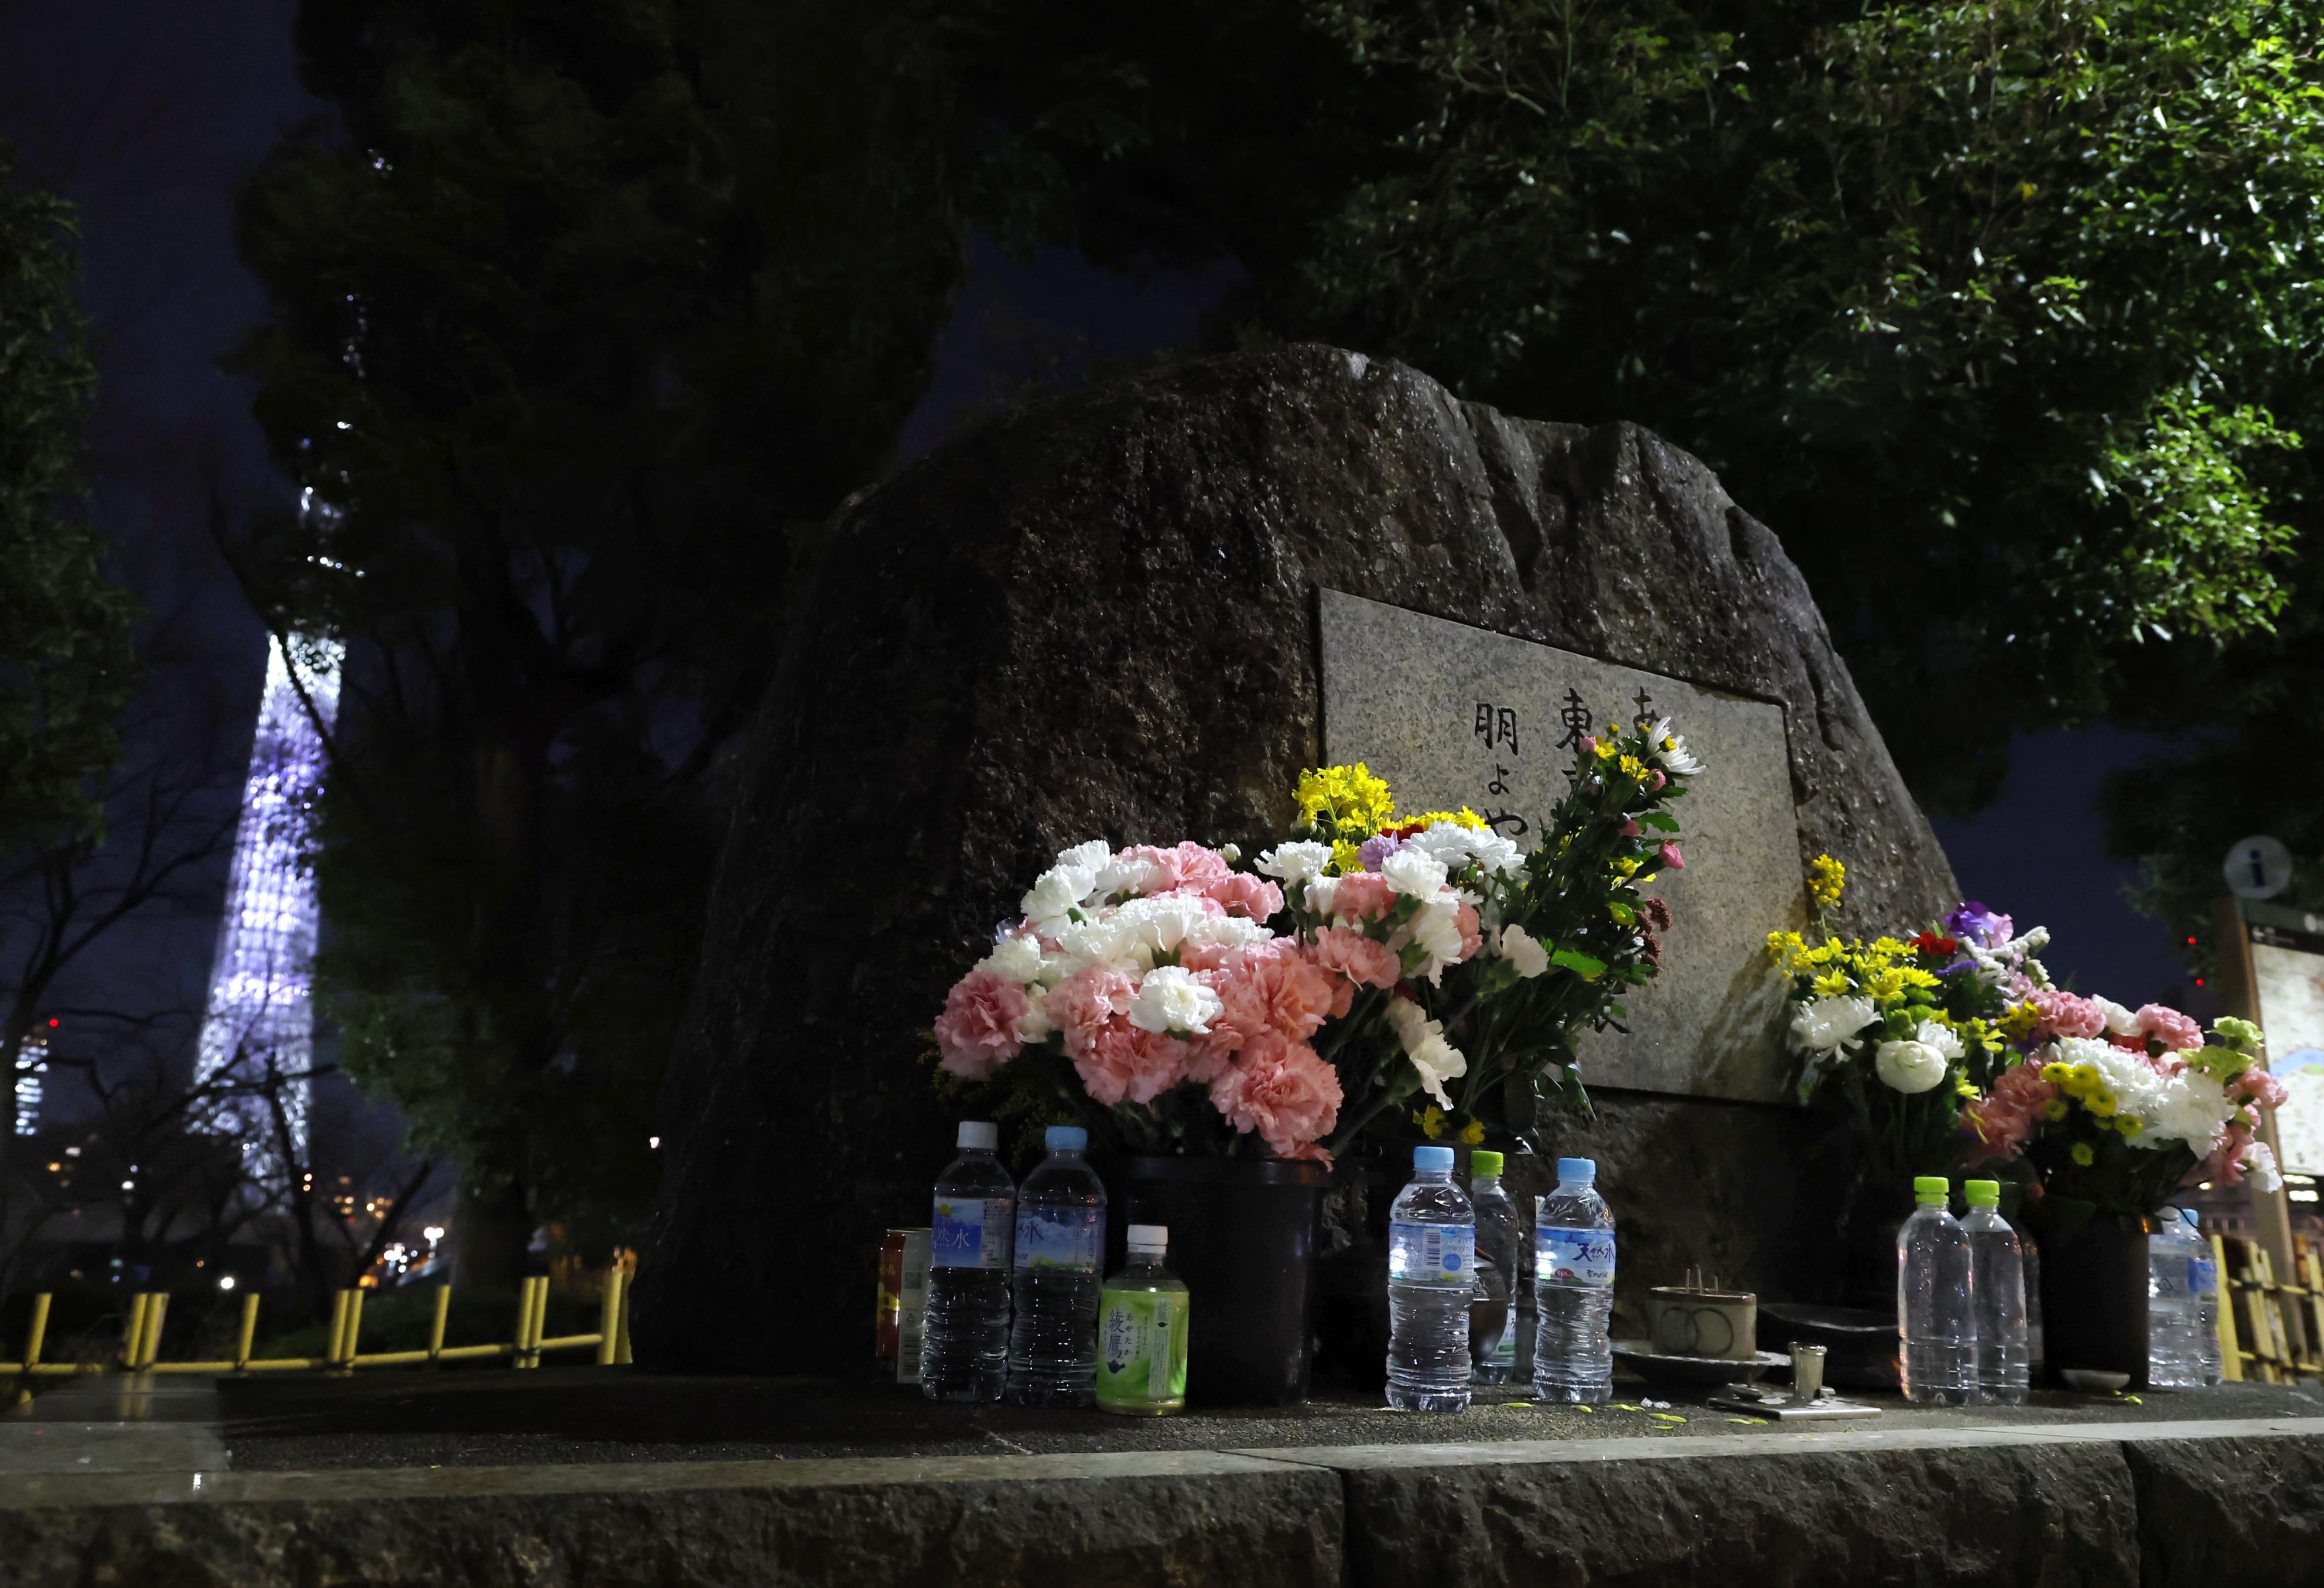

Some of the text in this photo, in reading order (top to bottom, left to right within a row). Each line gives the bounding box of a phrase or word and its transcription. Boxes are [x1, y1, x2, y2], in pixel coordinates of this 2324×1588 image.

[1571, 1243, 1615, 1263] 天然水
[1108, 1308, 1125, 1358] 綾鷹
[1125, 1313, 1134, 1356] あやたか
